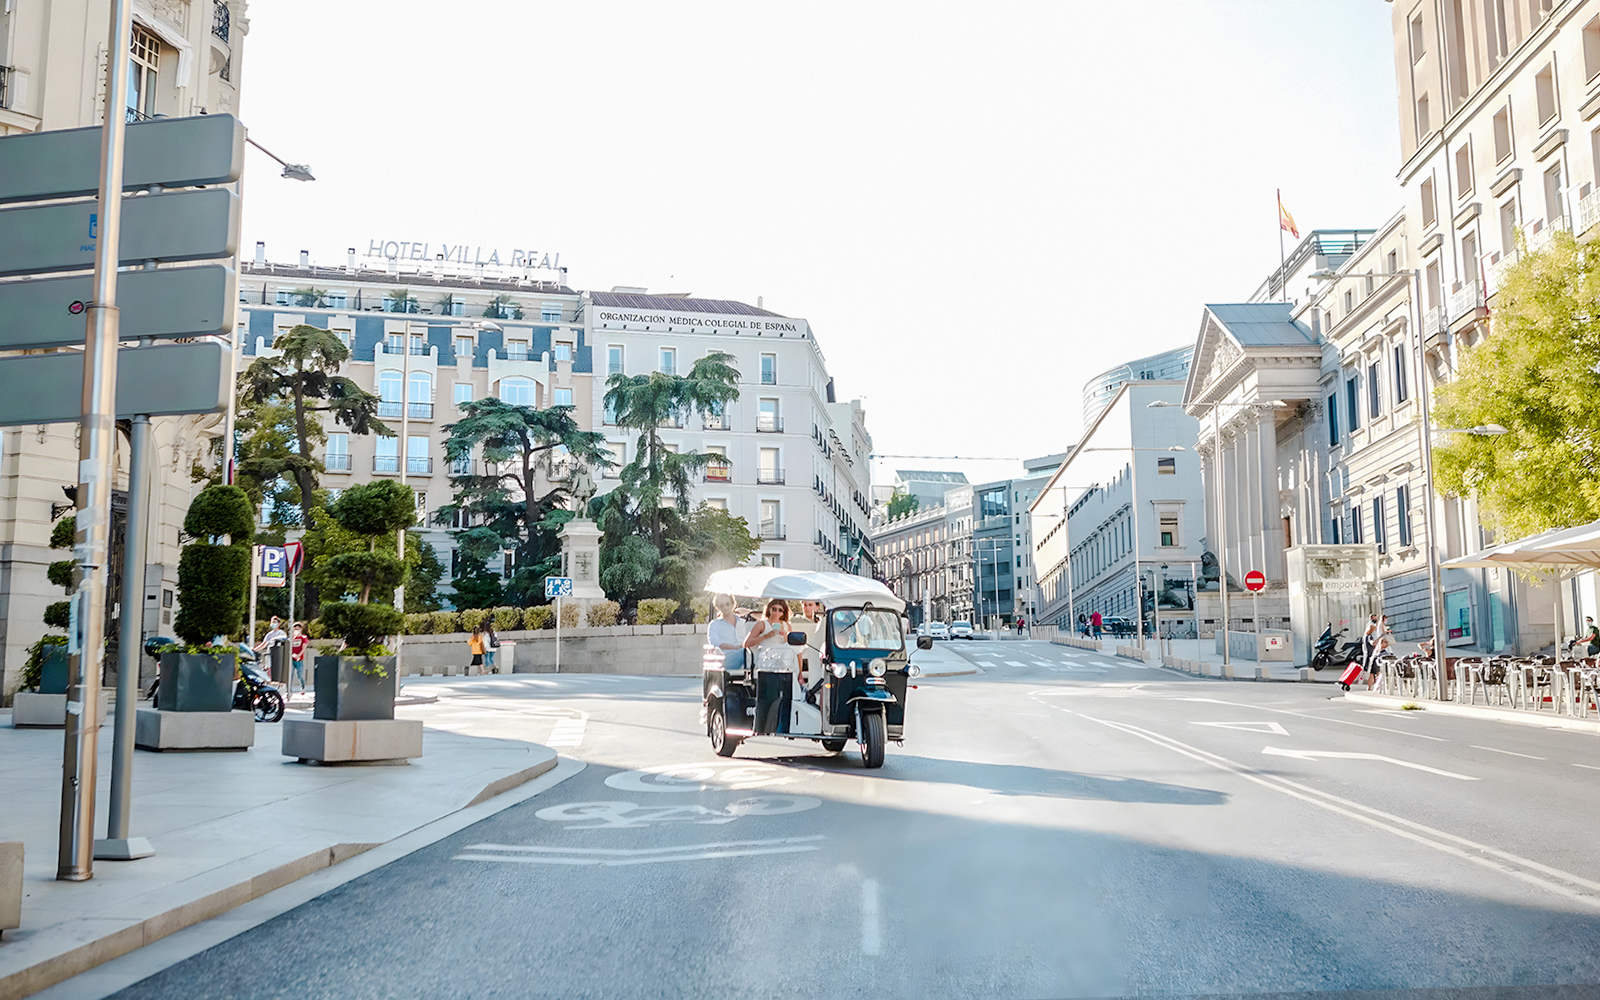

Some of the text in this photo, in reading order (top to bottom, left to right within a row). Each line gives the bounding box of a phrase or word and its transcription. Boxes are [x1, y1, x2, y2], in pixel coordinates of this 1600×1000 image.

[368, 239, 562, 271] HOTEL VILLA REAL
[704, 318, 748, 329] COLEGIAL
[750, 321, 762, 330] DE
[764, 321, 797, 332] ESPAÑA
[849, 660, 856, 679] 1
[794, 709, 799, 726] 1
